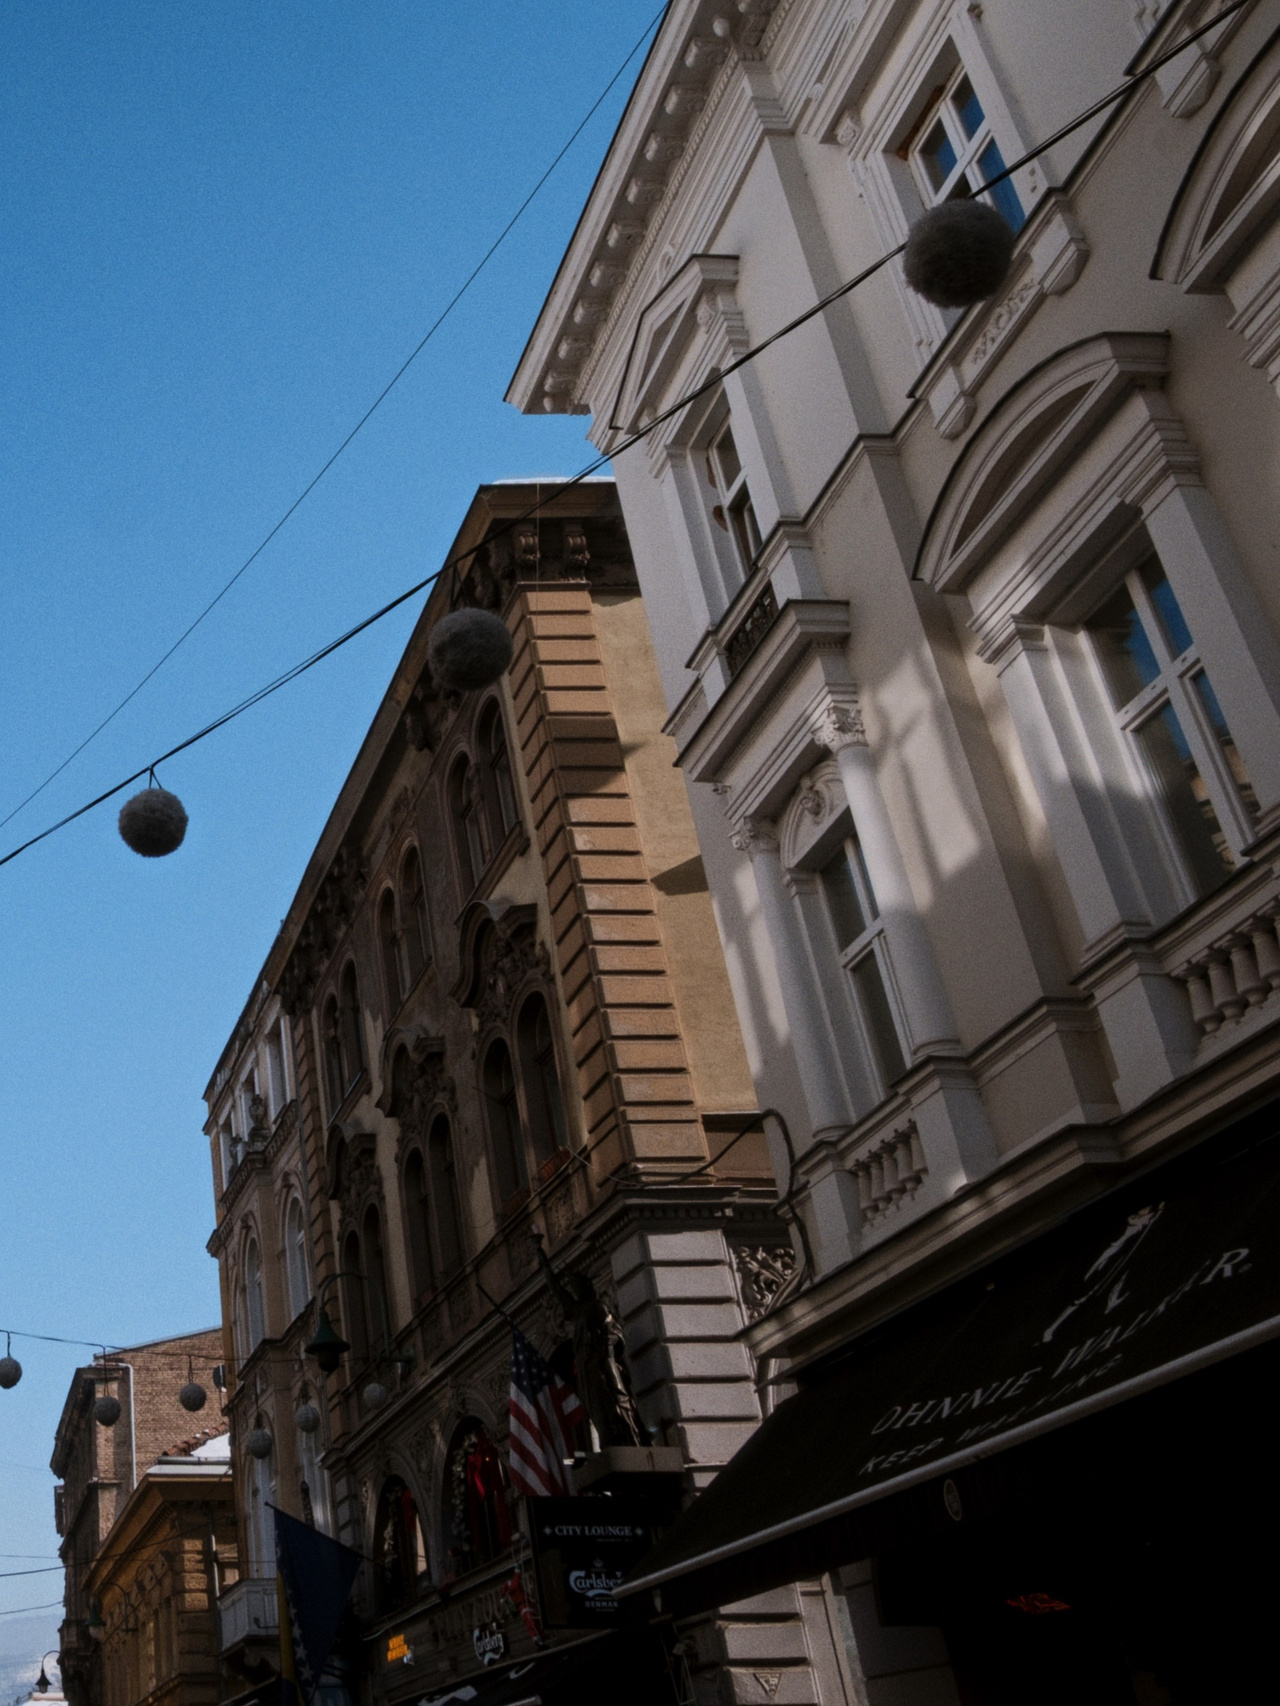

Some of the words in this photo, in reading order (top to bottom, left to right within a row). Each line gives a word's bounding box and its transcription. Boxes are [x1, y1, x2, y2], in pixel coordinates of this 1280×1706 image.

[554, 1525, 582, 1536] CITY
[584, 1525, 633, 1537] LOUNGE
[569, 1569, 624, 1594] Carlsber
